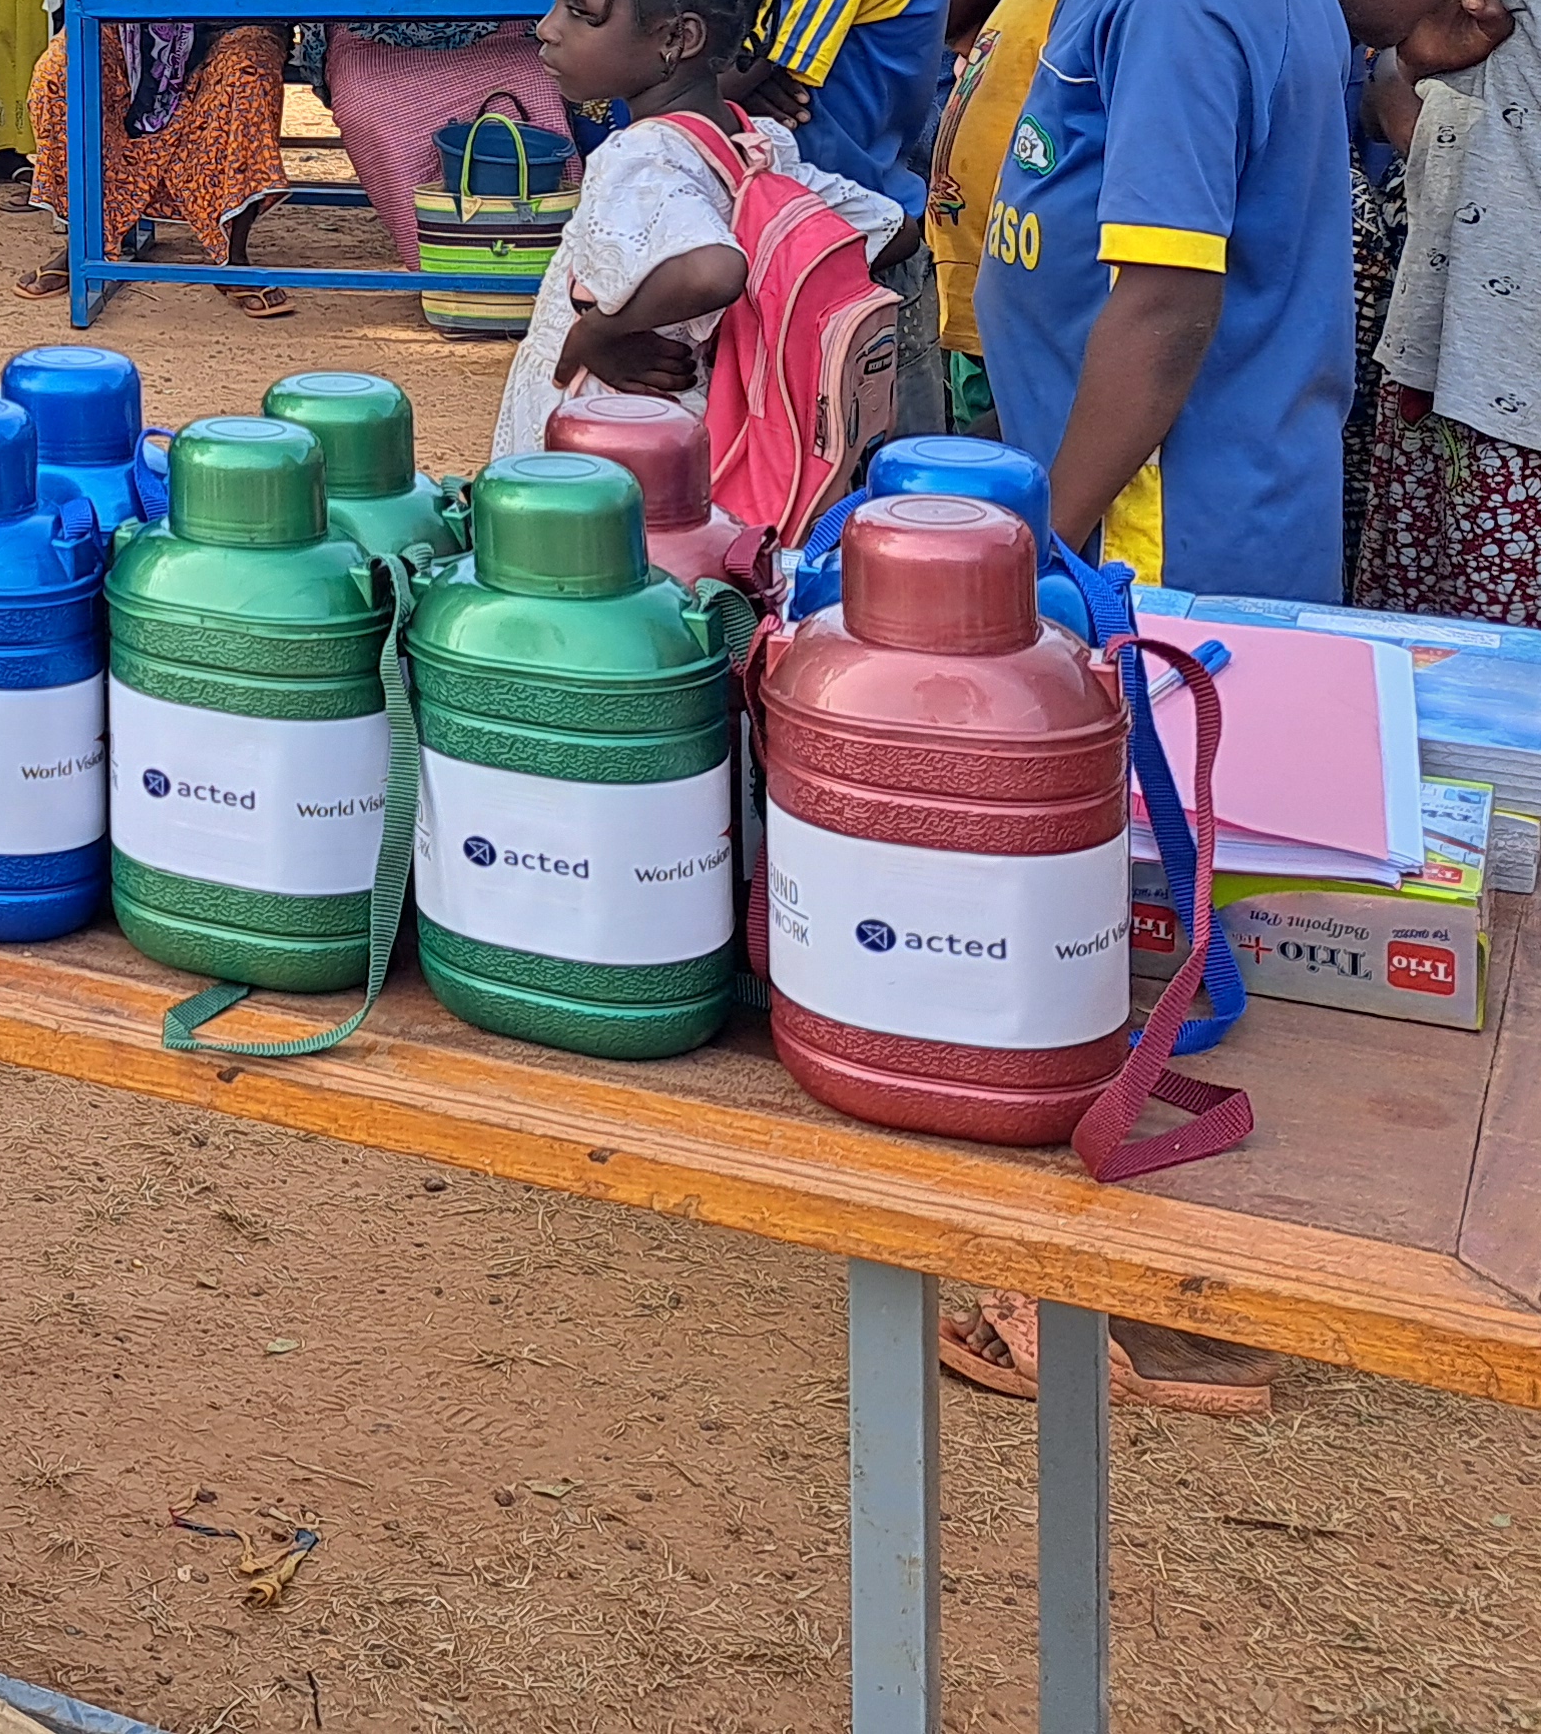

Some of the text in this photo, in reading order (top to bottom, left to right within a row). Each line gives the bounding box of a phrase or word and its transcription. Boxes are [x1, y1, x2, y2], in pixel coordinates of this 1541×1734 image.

[21, 756, 72, 781] World
[177, 781, 256, 811] acted
[296, 799, 355, 819] World
[503, 849, 590, 880] acted
[634, 845, 731, 883] World Vision
[1249, 909, 1370, 941] Ballpoint Pen
[905, 931, 1007, 961] acted
[1054, 929, 1110, 960] World
[1391, 954, 1454, 983] Trio
